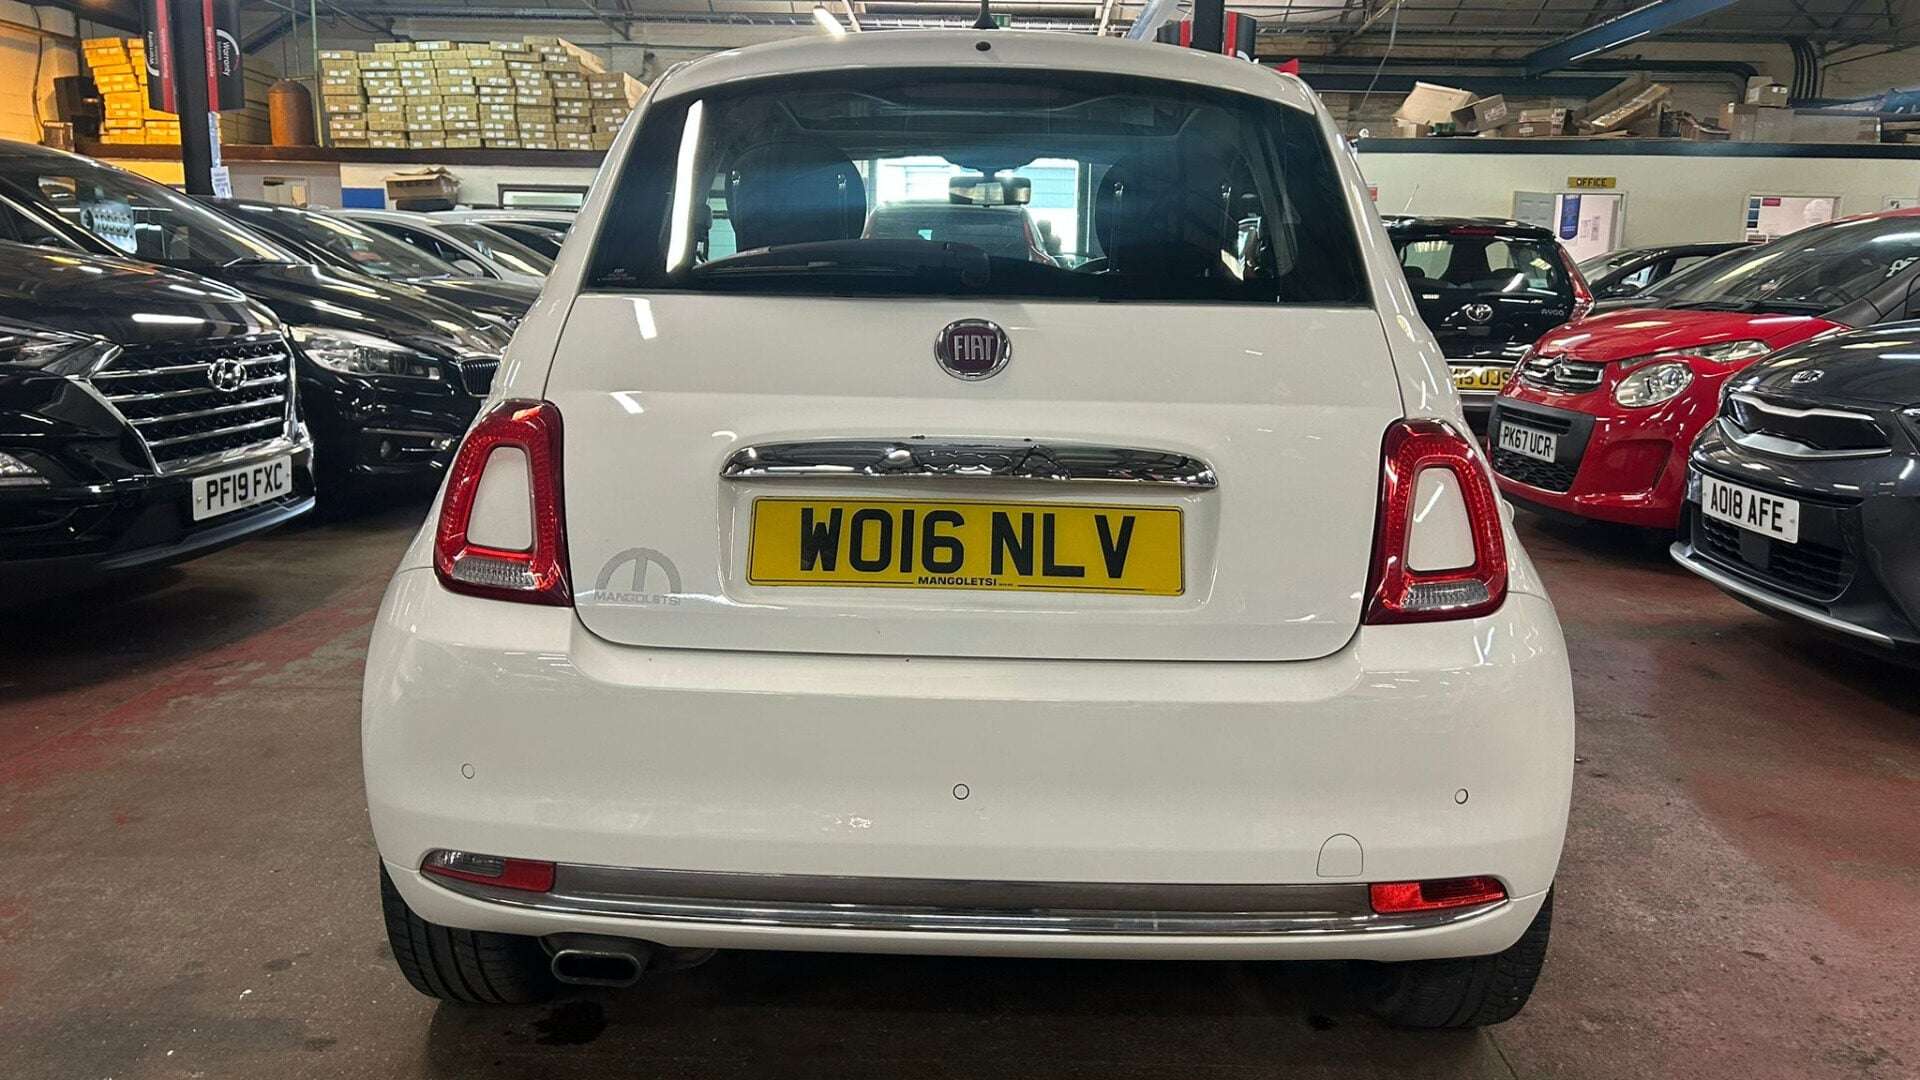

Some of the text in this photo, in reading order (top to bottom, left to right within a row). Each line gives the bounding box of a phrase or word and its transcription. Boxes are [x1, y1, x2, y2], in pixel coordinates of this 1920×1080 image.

[222, 41, 233, 76] Warranty
[1576, 178, 1607, 187] OFFICE
[954, 335, 994, 361] FIAT
[1503, 426, 1551, 457] PK67 UCR
[206, 463, 282, 510] PF19 FXC
[1710, 483, 1784, 533] AO18 AFE
[800, 507, 1136, 579] WO16 NLV
[918, 576, 997, 586] MANGOLETSI
[593, 591, 681, 607] MANGOLETSI
